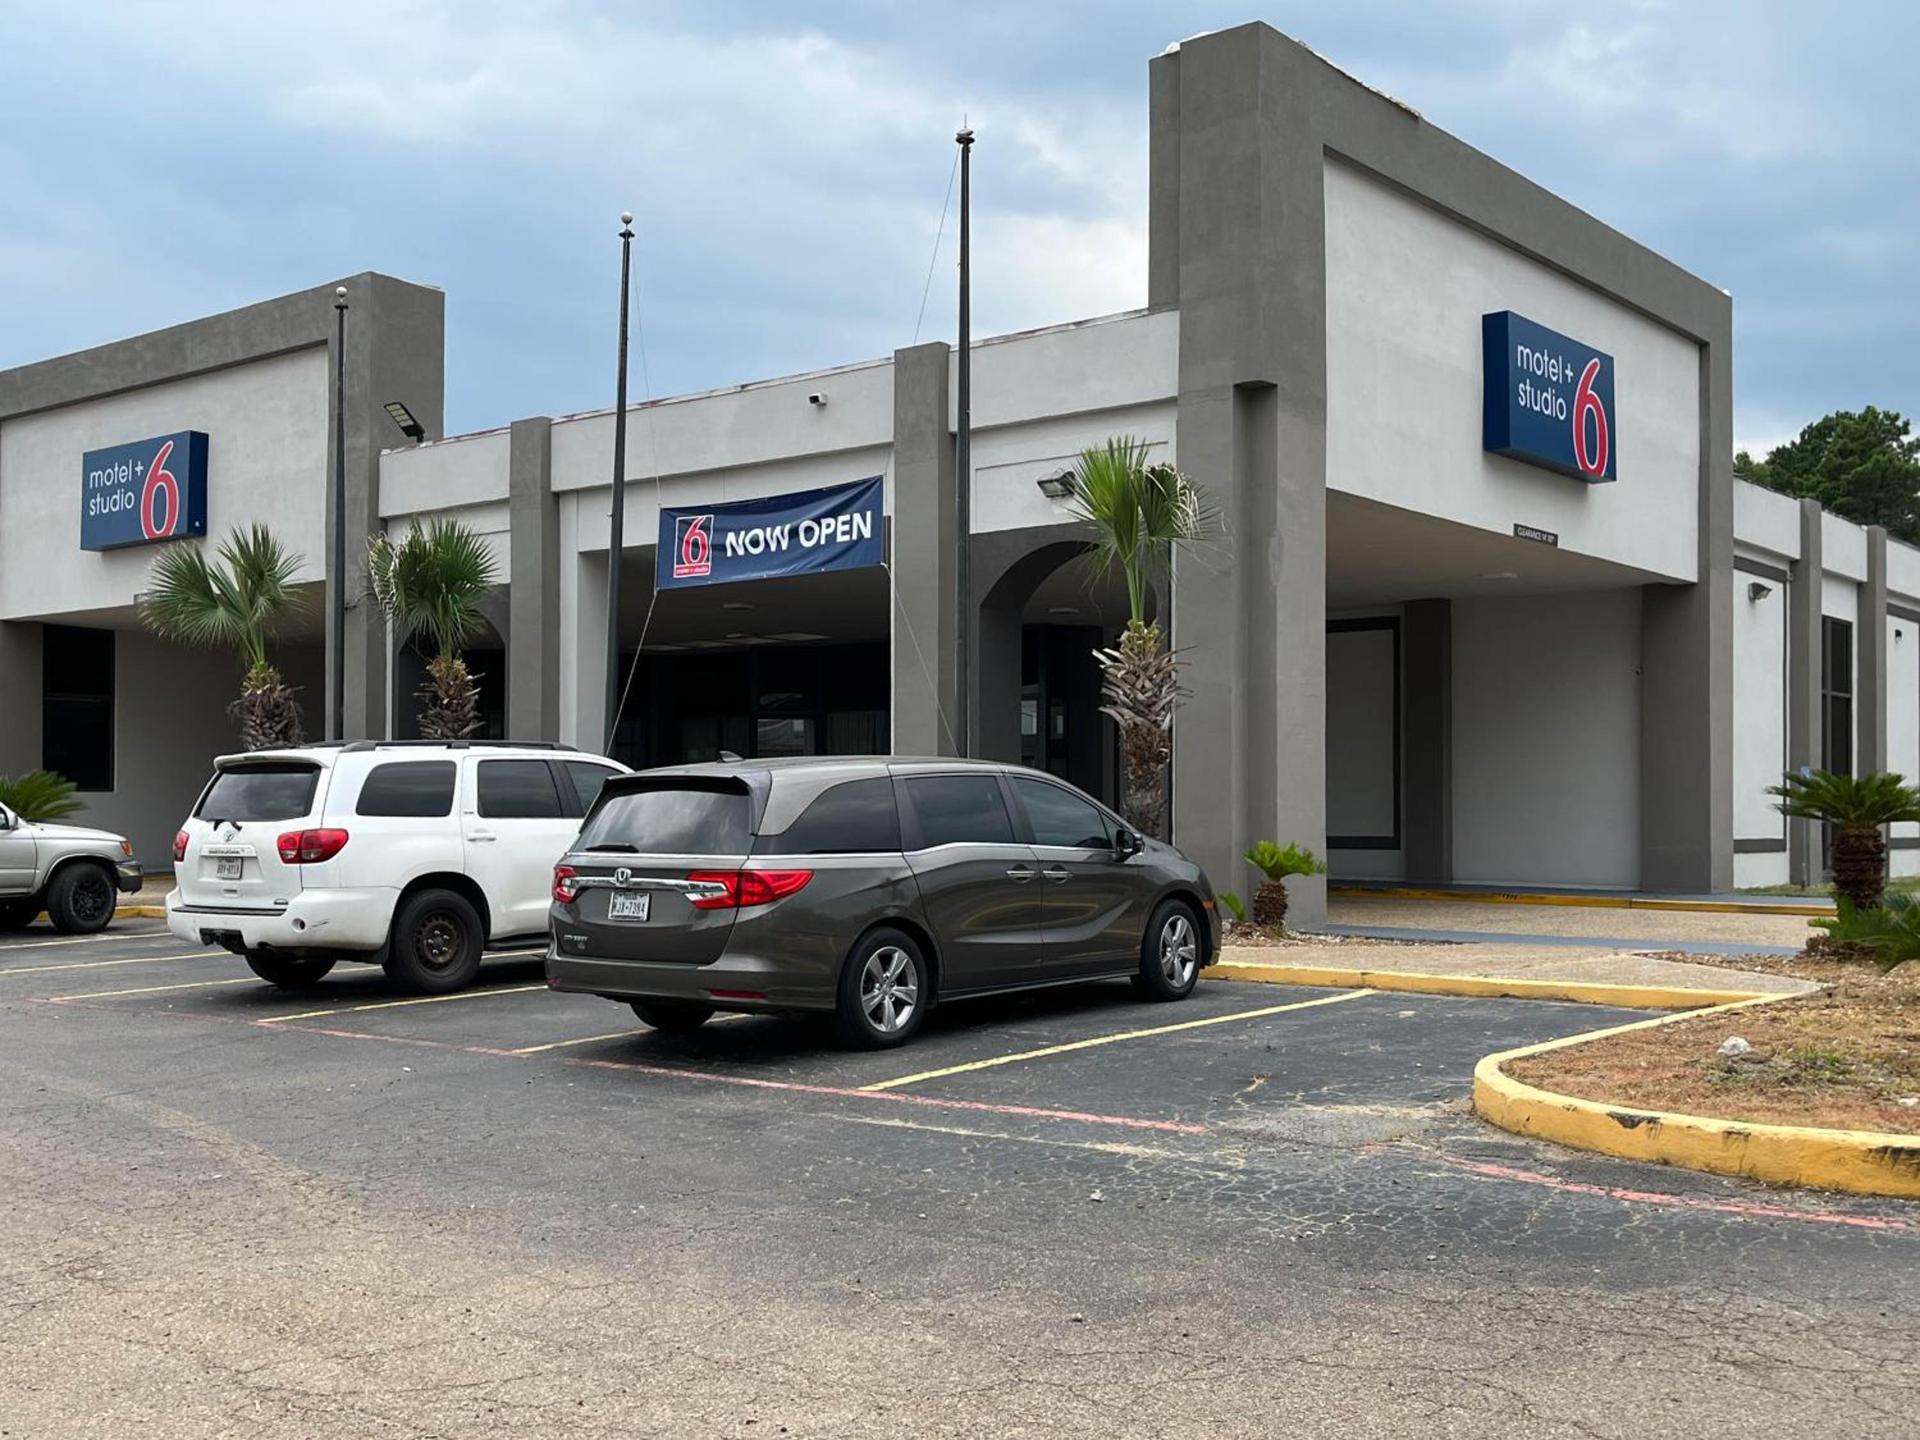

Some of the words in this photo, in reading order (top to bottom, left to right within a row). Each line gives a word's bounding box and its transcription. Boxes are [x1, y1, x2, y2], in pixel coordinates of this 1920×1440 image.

[1517, 344, 1562, 384] motel
[1518, 378, 1567, 420] studio
[1573, 357, 1609, 477] 6
[89, 459, 132, 488] motel
[140, 440, 179, 539] 6
[89, 488, 135, 516] studio
[682, 516, 709, 565] 6
[725, 523, 790, 557] NOW
[798, 511, 872, 547] OPEN
